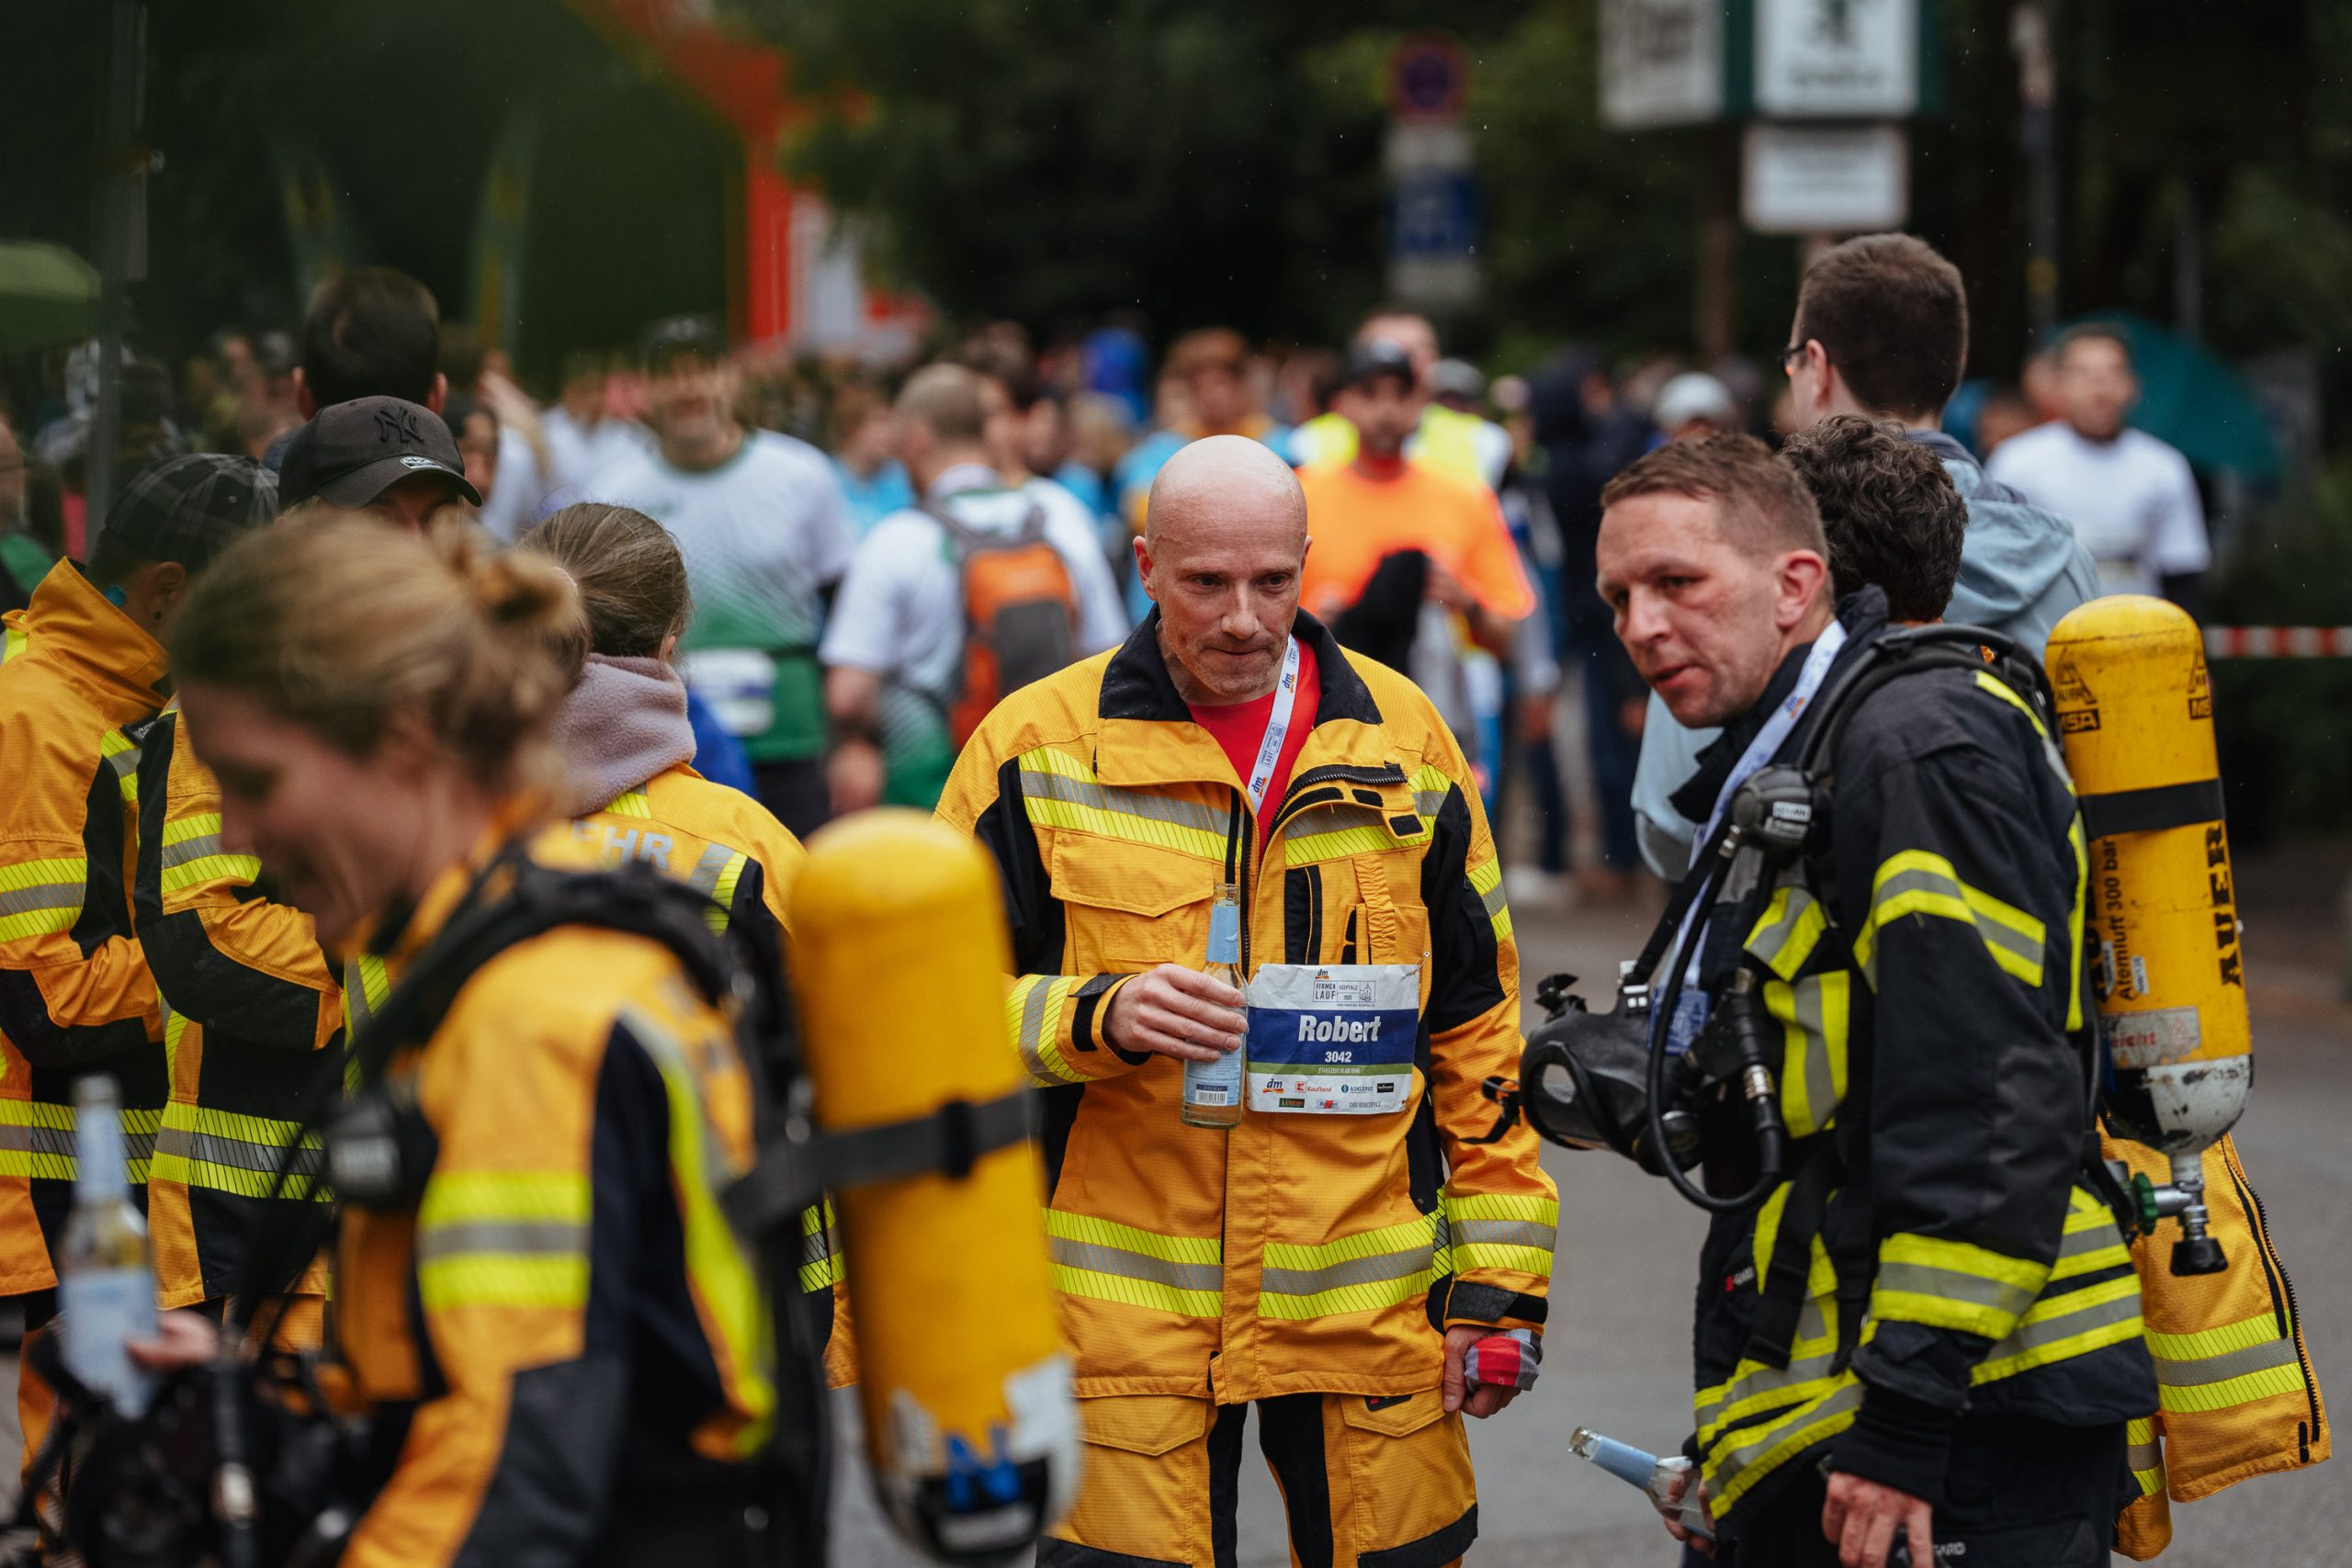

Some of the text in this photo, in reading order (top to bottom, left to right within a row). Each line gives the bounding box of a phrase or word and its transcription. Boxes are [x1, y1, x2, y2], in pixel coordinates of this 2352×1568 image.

[1251, 776, 1262, 794] dm
[2207, 824, 2241, 987] AUER
[2102, 840, 2133, 1001] Atemluft 300 bar
[1315, 991, 1336, 999] LAUF
[1298, 1015, 1381, 1043] Robert
[1325, 1051, 1352, 1063] 3042
[1267, 1078, 1283, 1089] dm
